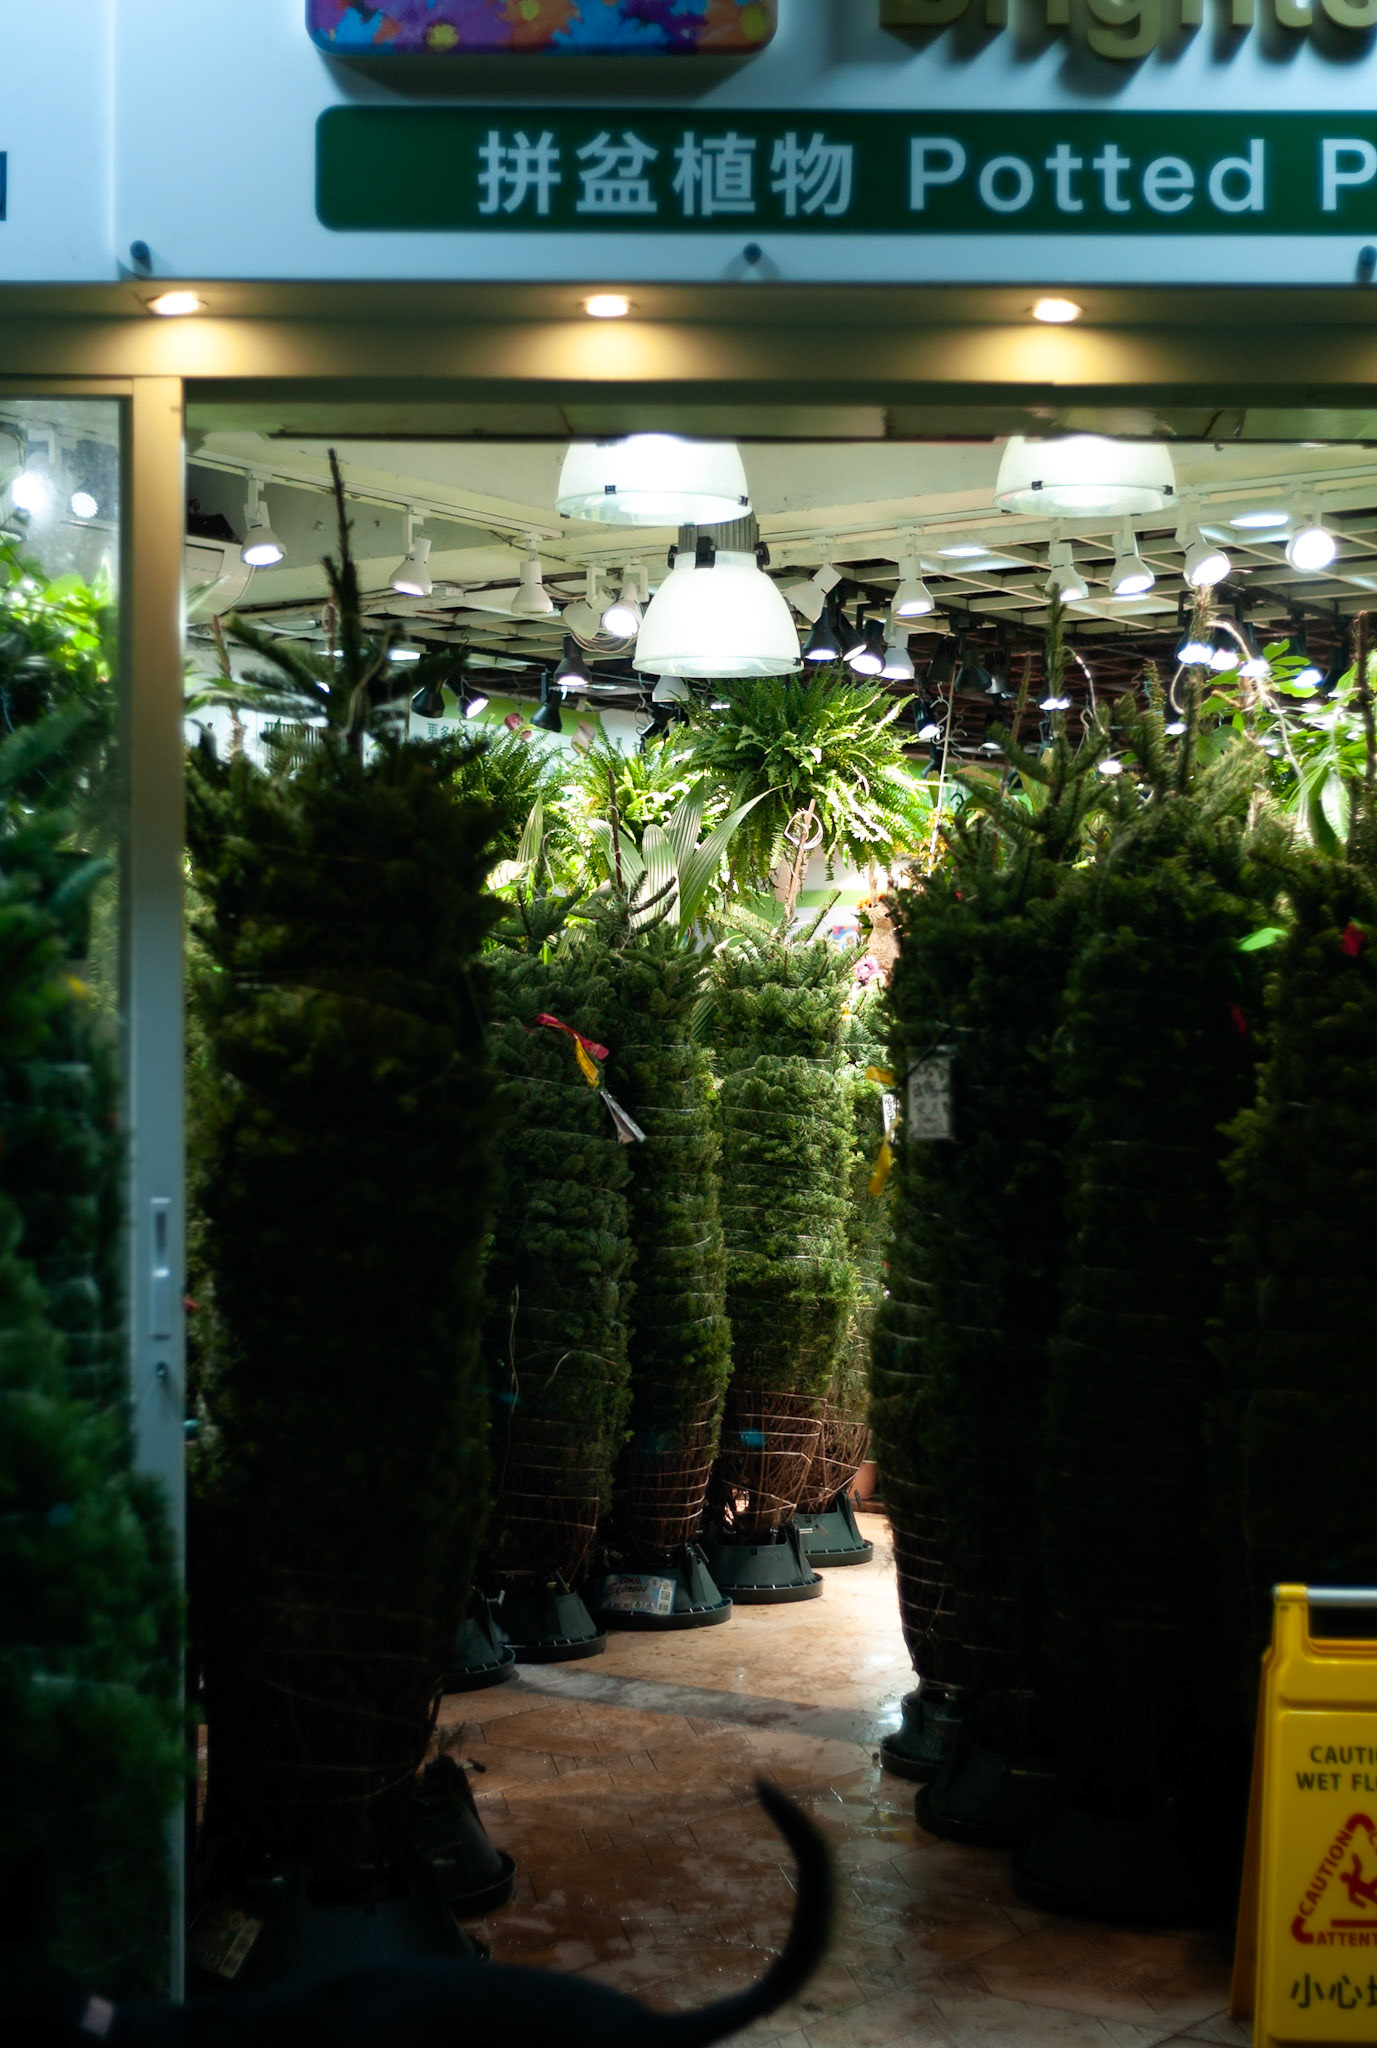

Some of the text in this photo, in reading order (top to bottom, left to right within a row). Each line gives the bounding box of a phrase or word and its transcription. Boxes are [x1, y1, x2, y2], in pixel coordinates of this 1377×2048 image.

[478, 130, 854, 217] 拼盆植物
[910, 137, 1265, 213] Potted
[1296, 1772, 1377, 1792] WET FL
[1310, 1745, 1377, 1765] CAUTI
[1299, 1829, 1353, 1917] CAUTION
